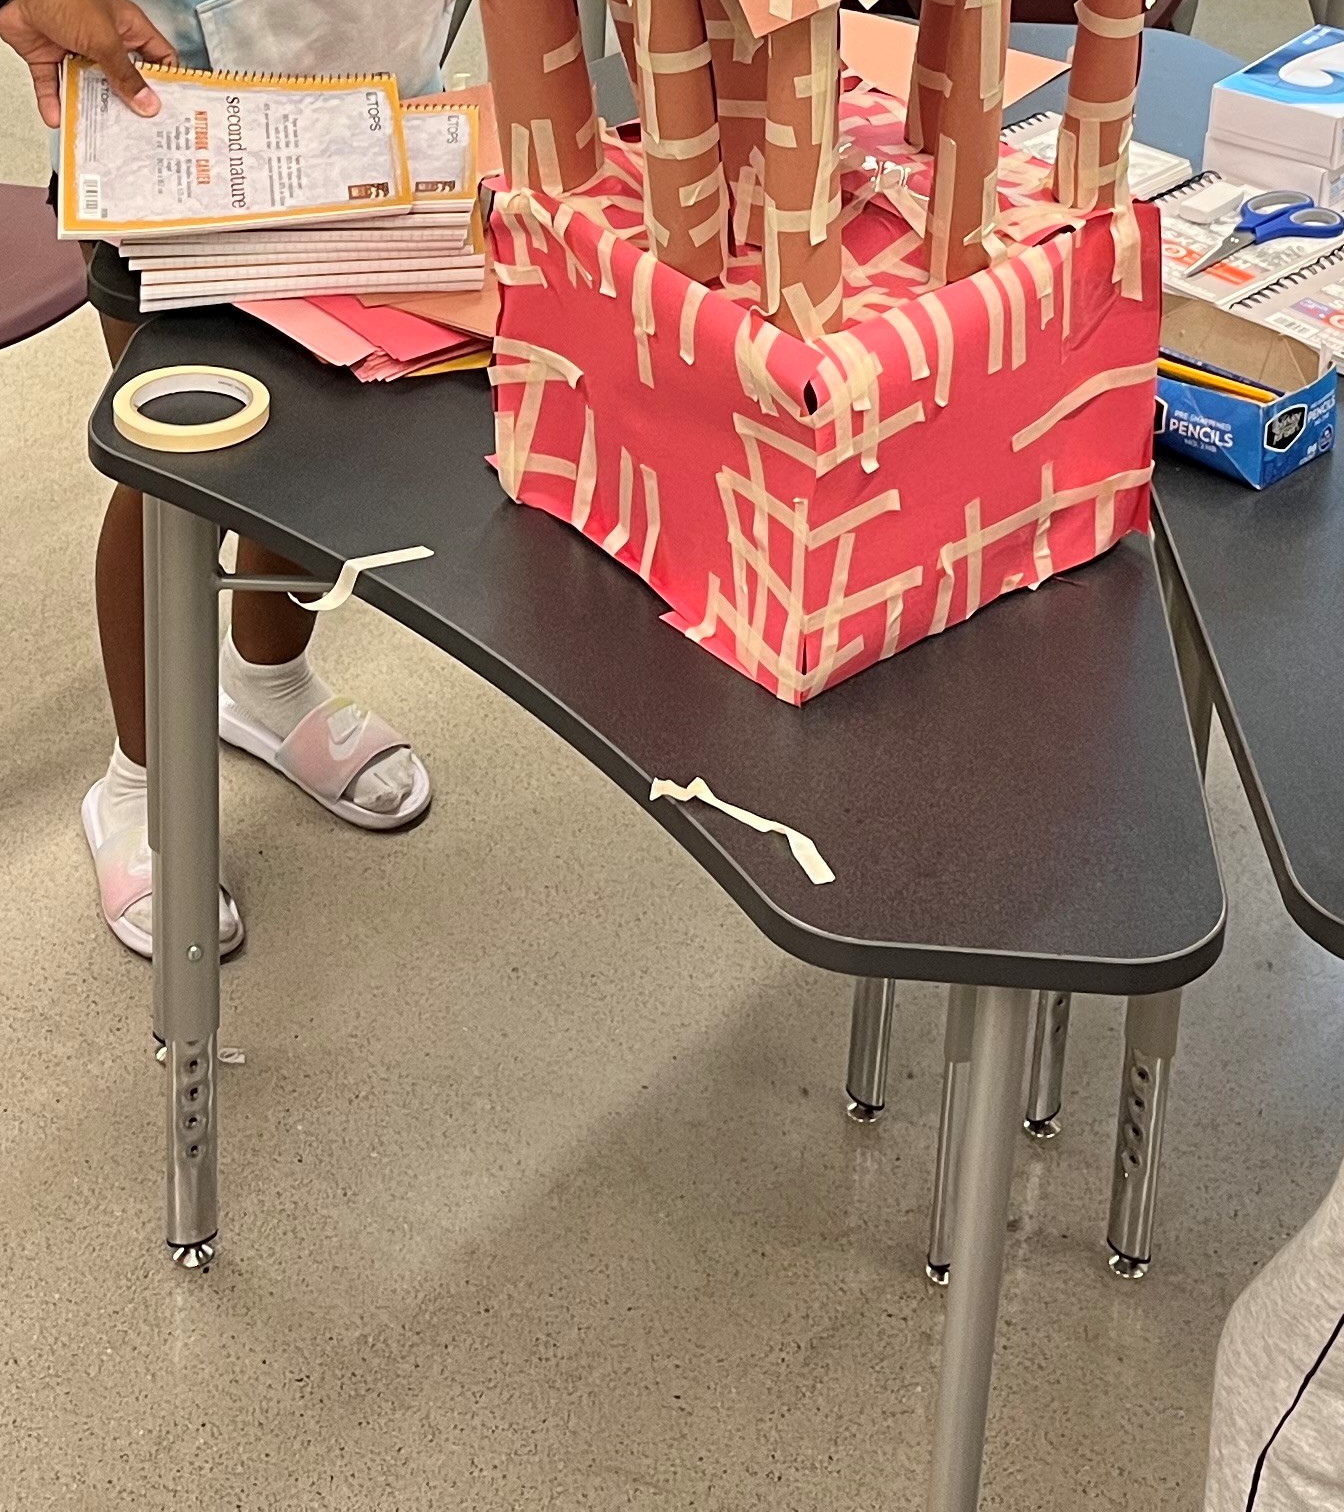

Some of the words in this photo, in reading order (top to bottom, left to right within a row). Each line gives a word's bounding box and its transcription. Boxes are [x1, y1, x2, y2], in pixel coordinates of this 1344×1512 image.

[225, 95, 248, 153] second
[367, 100, 382, 132] TOPS
[446, 121, 459, 144] TOPS
[229, 156, 248, 209] nature
[1169, 417, 1234, 448] PENCILS
